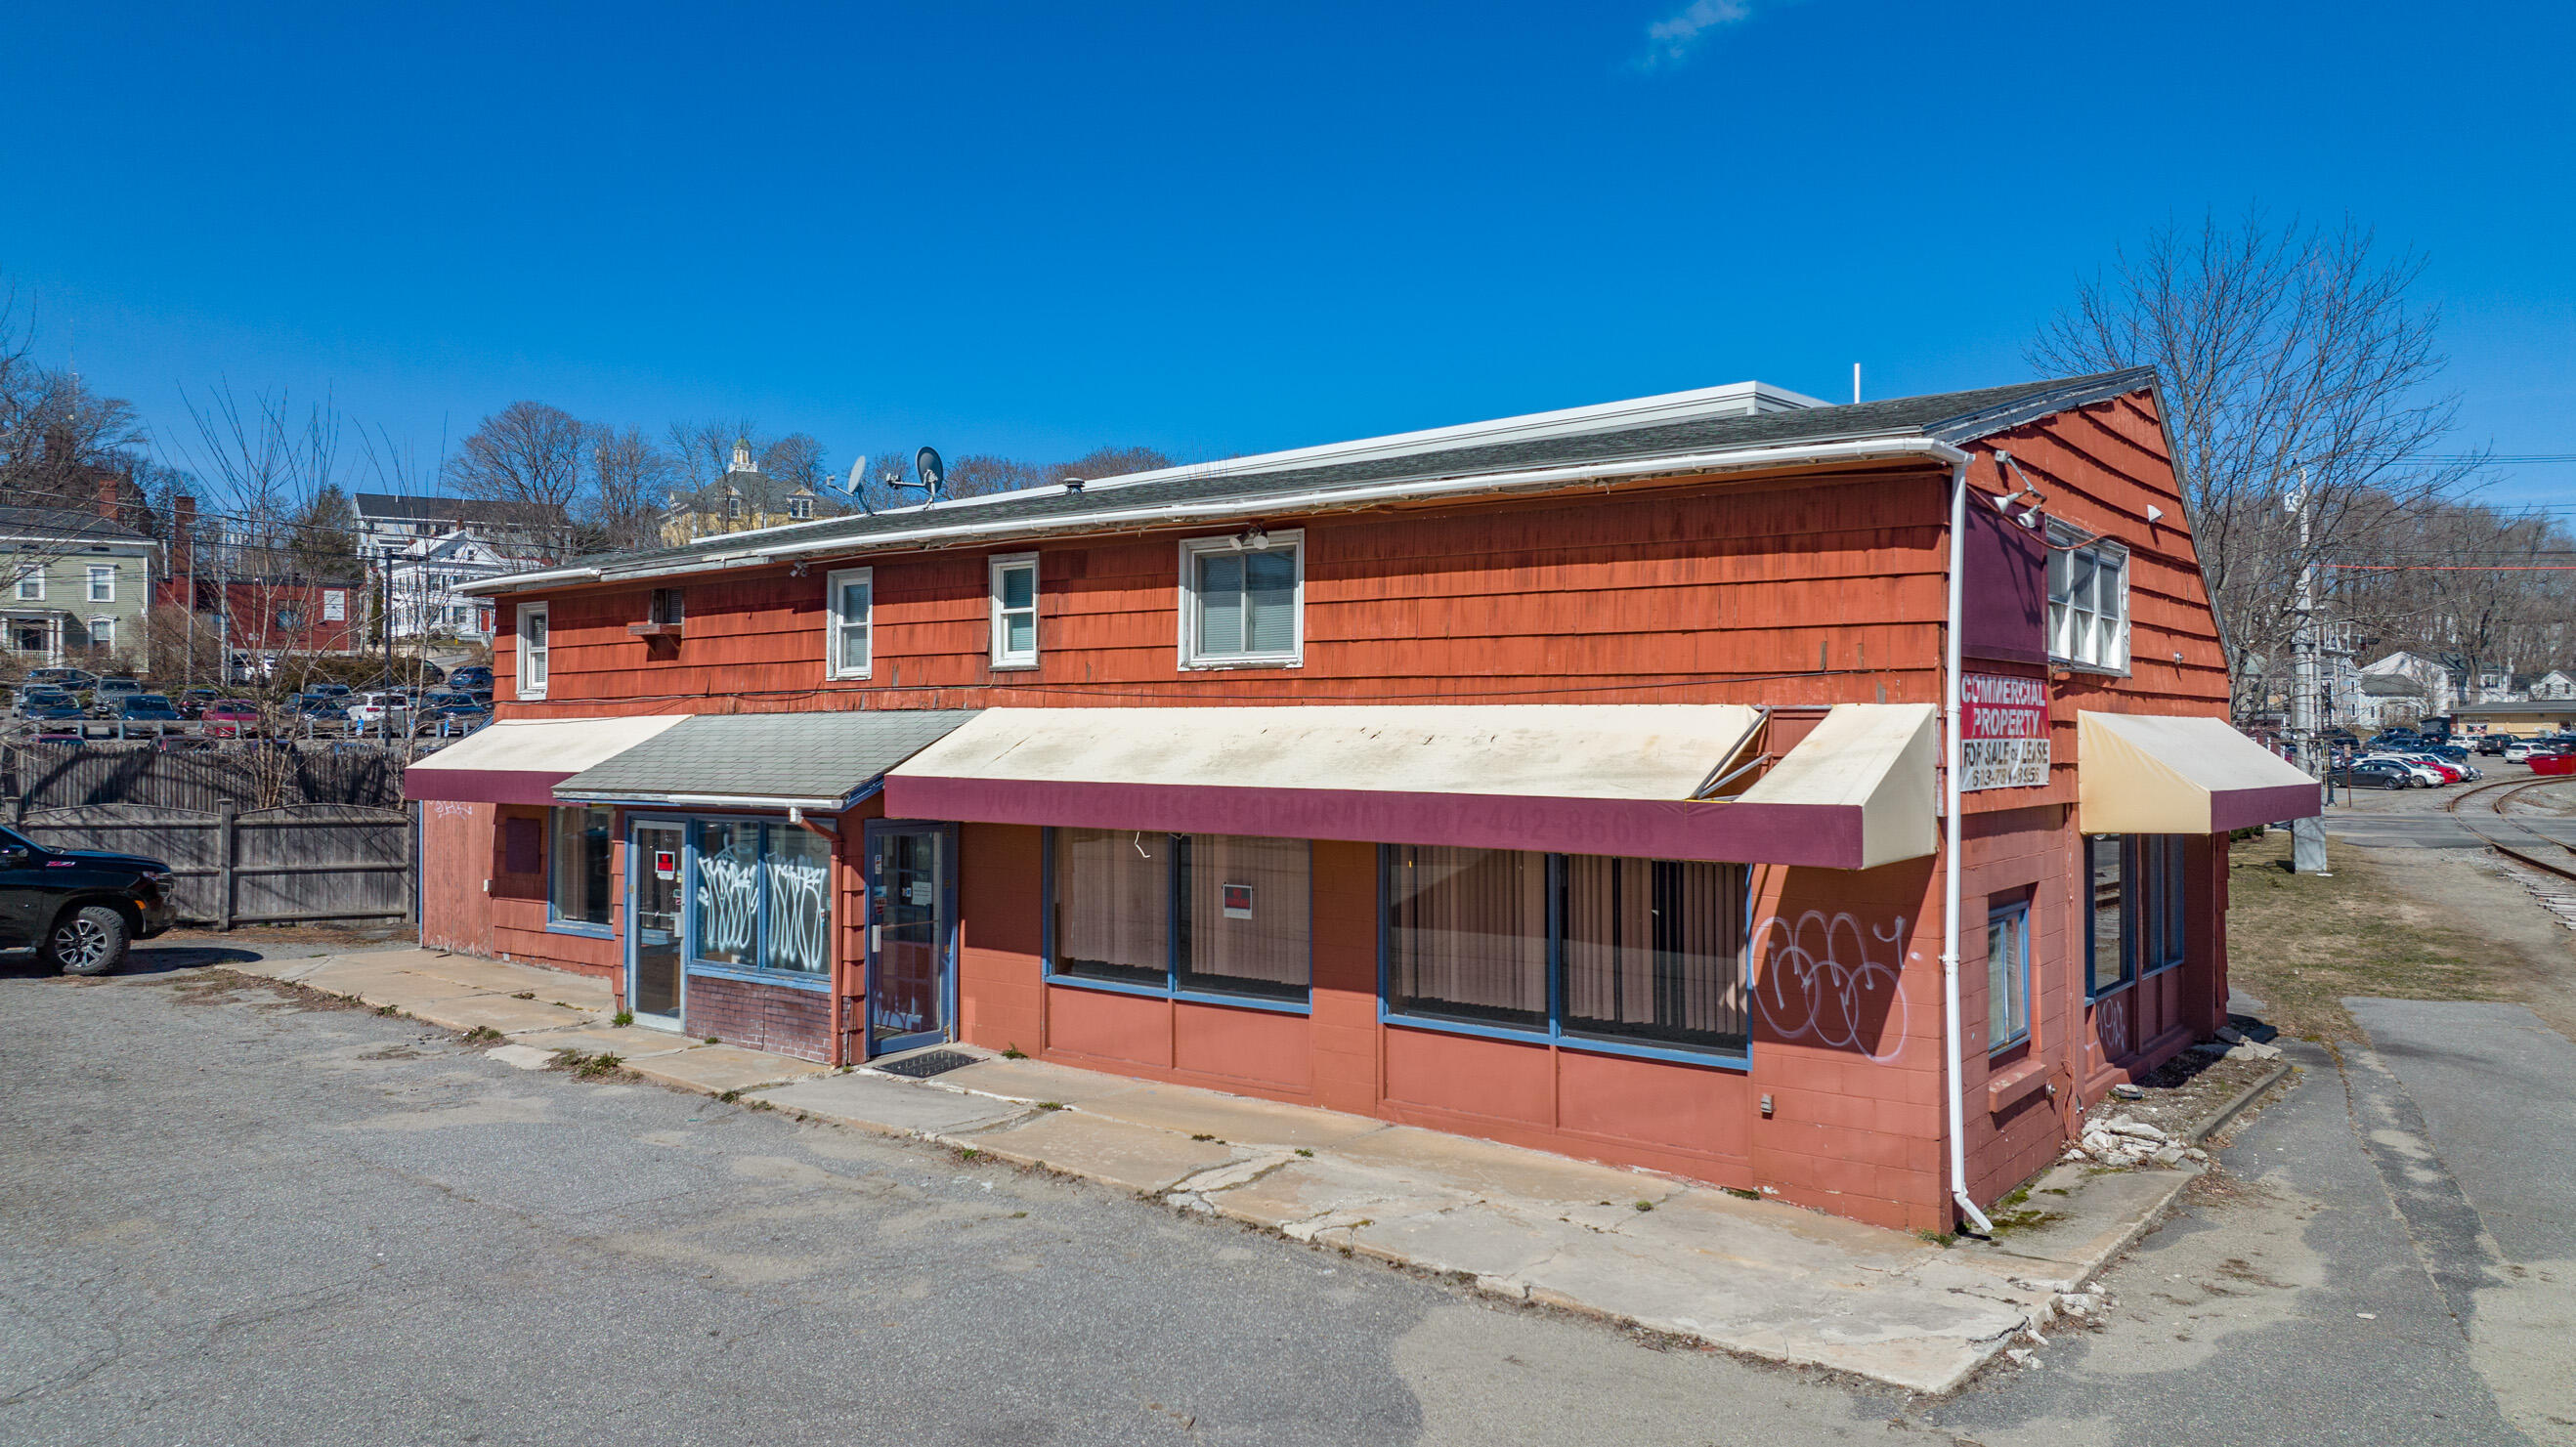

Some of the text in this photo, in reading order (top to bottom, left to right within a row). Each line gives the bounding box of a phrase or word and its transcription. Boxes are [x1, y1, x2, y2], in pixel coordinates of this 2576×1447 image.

[1961, 674, 2045, 706] COMMERCIAL
[1973, 707, 2040, 736] PROPERTY
[1964, 742, 1982, 767] FOR
[1985, 742, 2010, 766] SALE
[2021, 742, 2048, 764] LEASE
[1213, 794, 1396, 834] RESTAURANT
